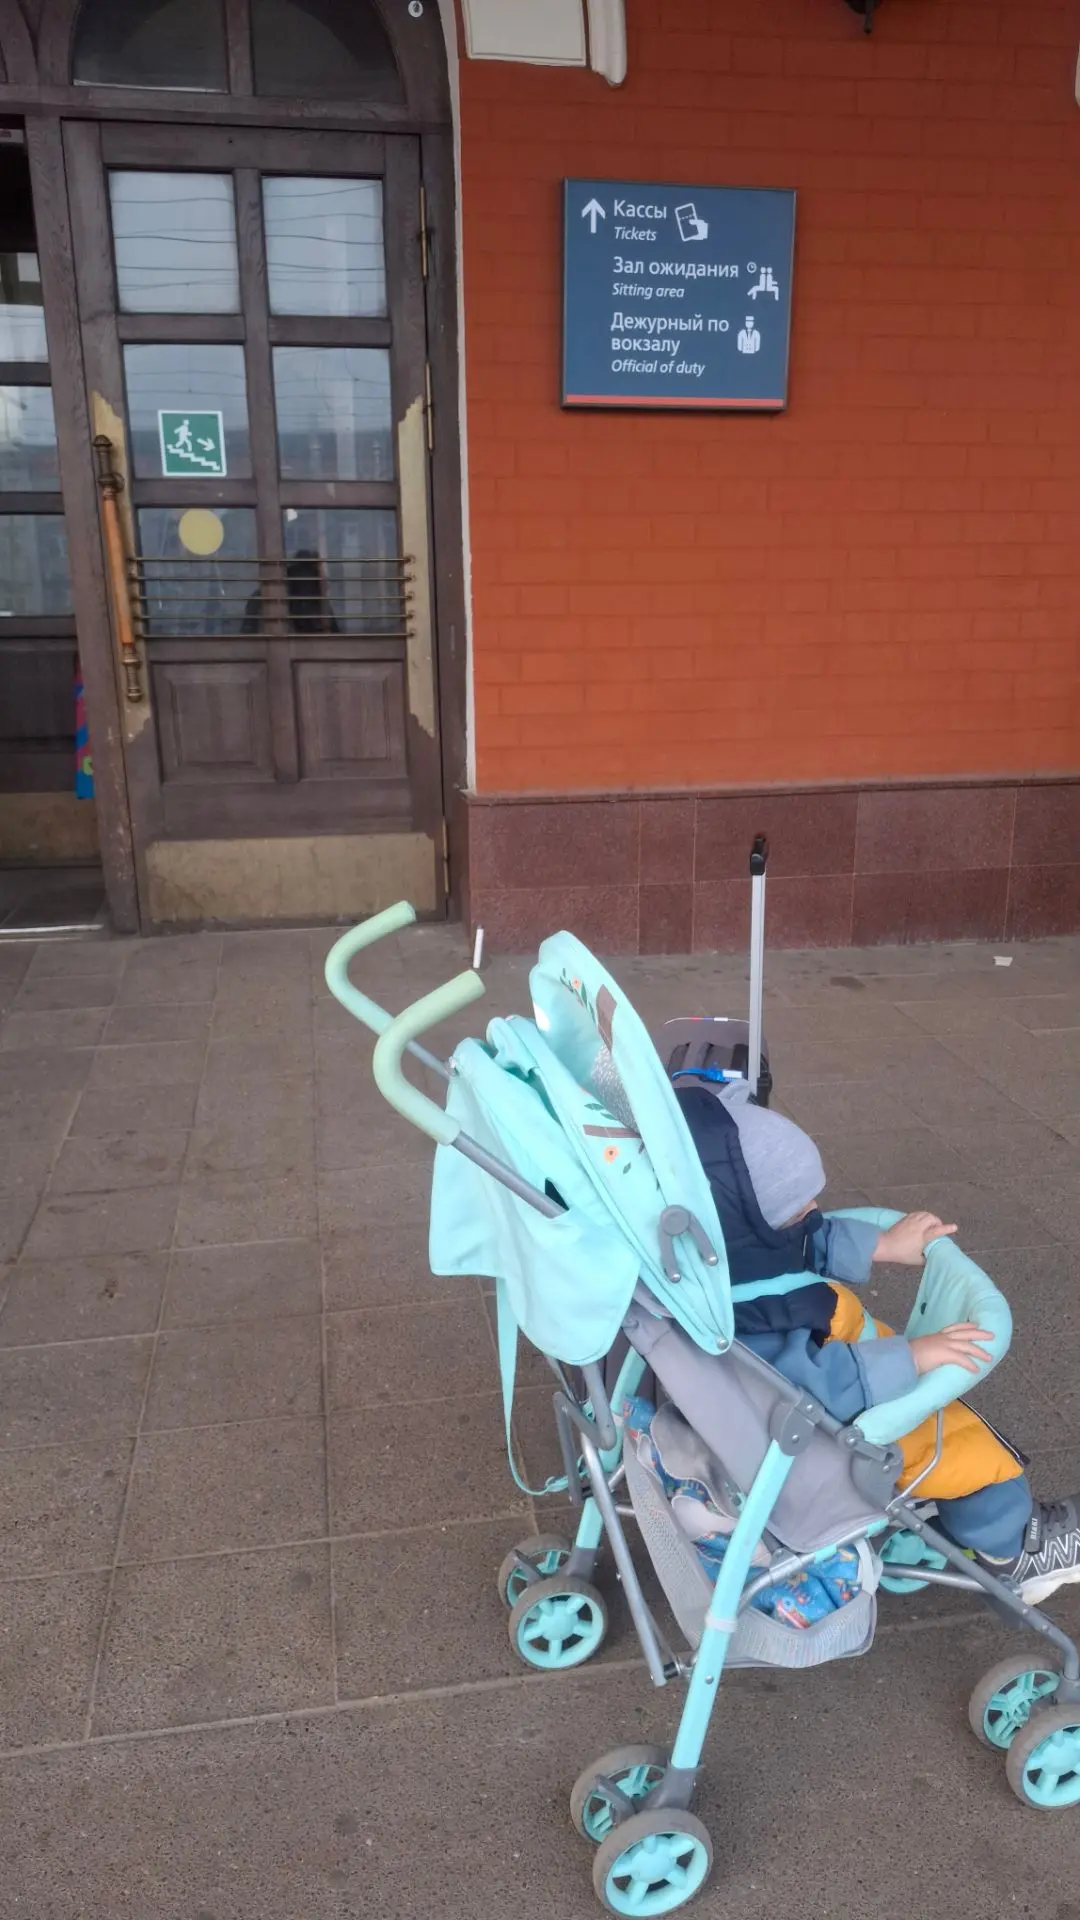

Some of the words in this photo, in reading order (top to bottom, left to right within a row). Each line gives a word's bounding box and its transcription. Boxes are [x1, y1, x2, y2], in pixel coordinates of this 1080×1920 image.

[613, 199, 667, 219] Кассы
[614, 226, 657, 241] Tickets
[613, 256, 644, 274] Зал
[649, 261, 739, 279] ожидания
[612, 282, 653, 300] Sitting
[656, 287, 685, 298] area
[611, 312, 703, 334] Дежурный
[708, 319, 729, 332] по
[611, 338, 680, 356] вокзалу
[611, 359, 657, 373] Official
[660, 360, 675, 373] of
[676, 361, 705, 377] duty
